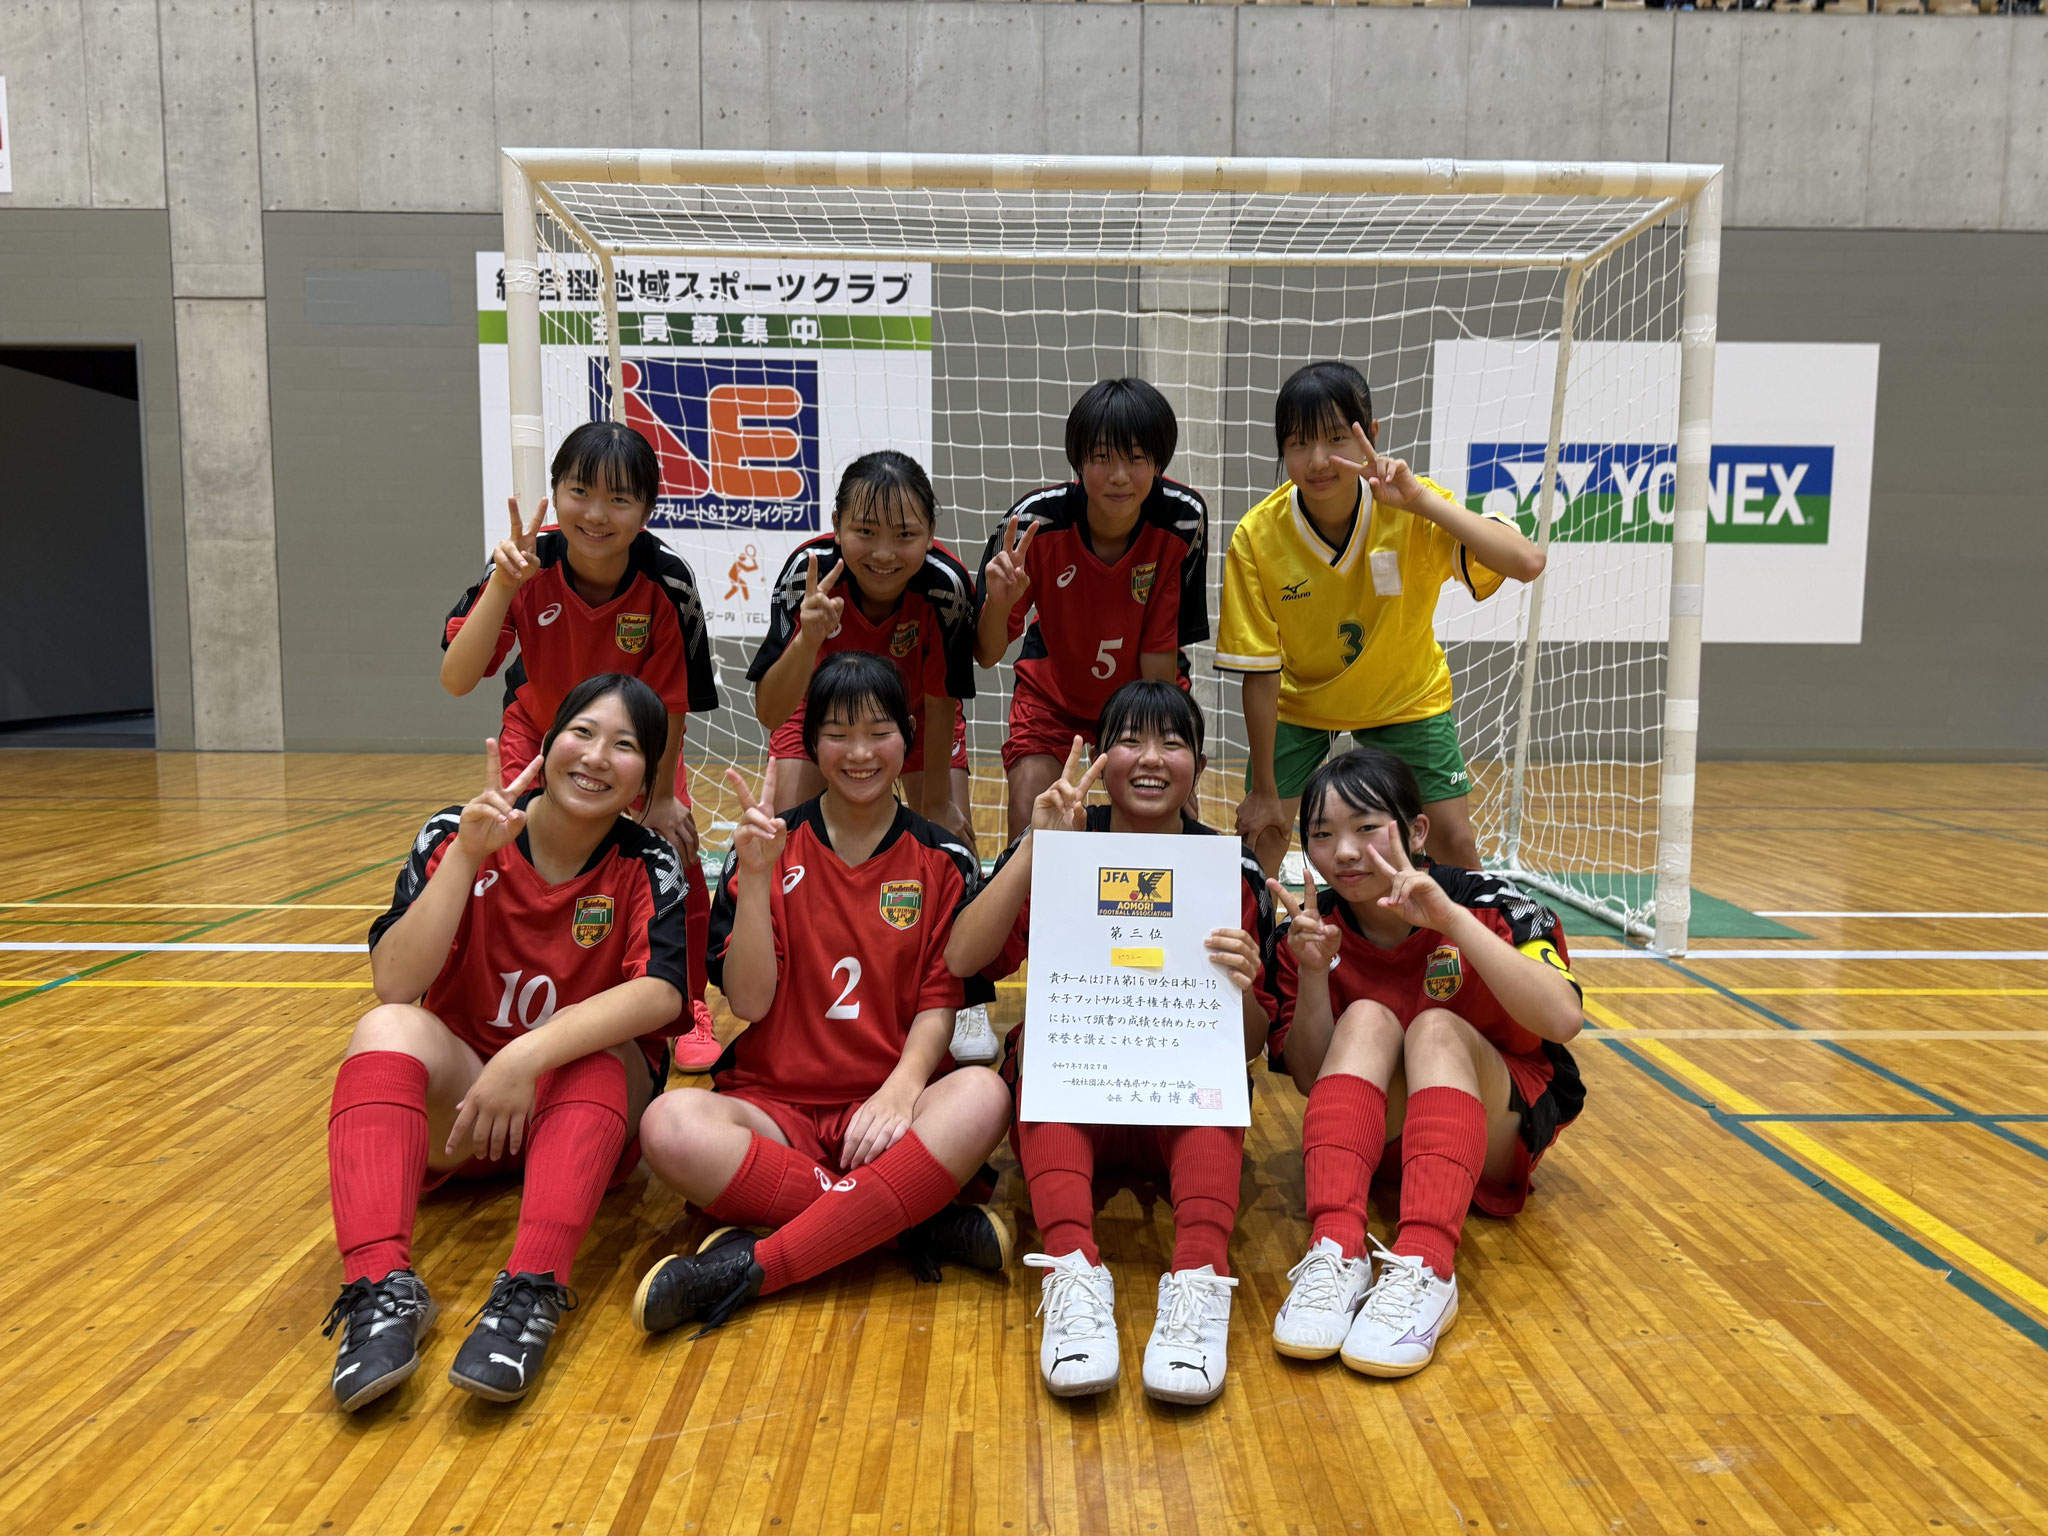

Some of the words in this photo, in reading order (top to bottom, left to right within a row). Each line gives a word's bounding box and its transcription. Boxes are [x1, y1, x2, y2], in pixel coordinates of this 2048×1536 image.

[496, 268, 913, 305] 合型地域スポーツクラブ
[1610, 461, 1810, 526] YONEX
[651, 502, 805, 524] アスリート&エンジョイクラブ
[745, 612, 769, 624] TEL
[1091, 637, 1124, 680] 5
[1337, 619, 1365, 668] 3
[1103, 872, 1130, 883] JFA
[1117, 902, 1154, 911] AOMORI
[1111, 926, 1163, 941] 第三位
[486, 969, 557, 1030] 10
[825, 956, 862, 1020] 2
